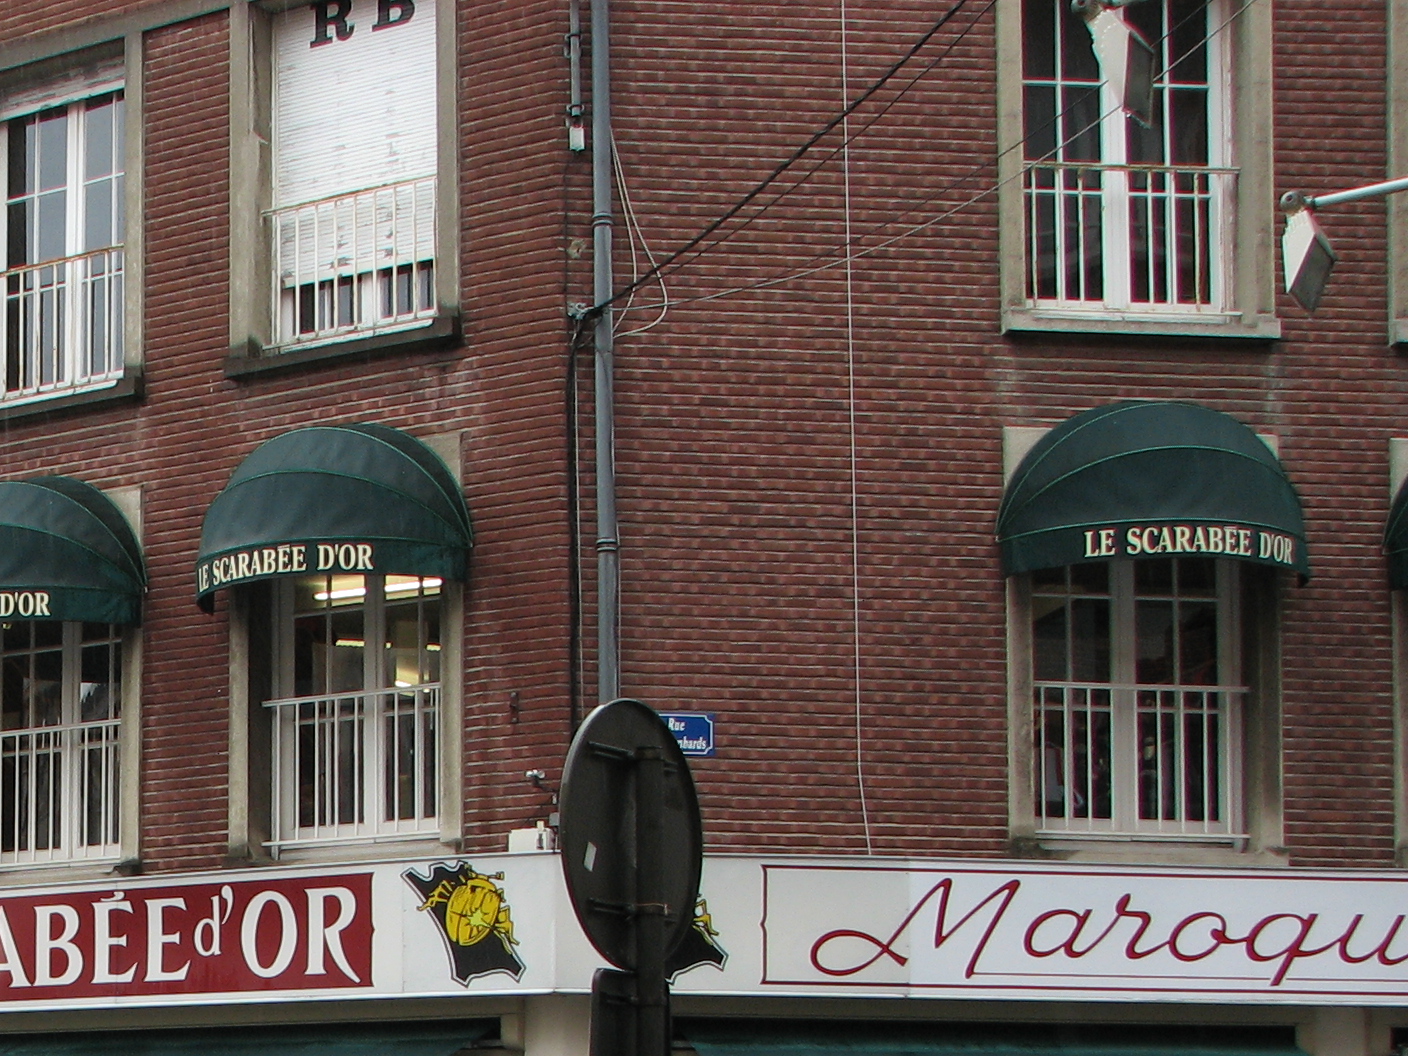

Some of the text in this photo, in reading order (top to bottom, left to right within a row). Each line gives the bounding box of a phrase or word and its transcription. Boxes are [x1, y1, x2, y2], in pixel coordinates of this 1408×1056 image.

[1084, 529, 1116, 557] LE
[1258, 531, 1294, 564] D'OR
[198, 563, 210, 593] LE
[317, 543, 374, 571] D'OR
[668, 717, 686, 731] Rue
[194, 884, 361, 985] d'OR
